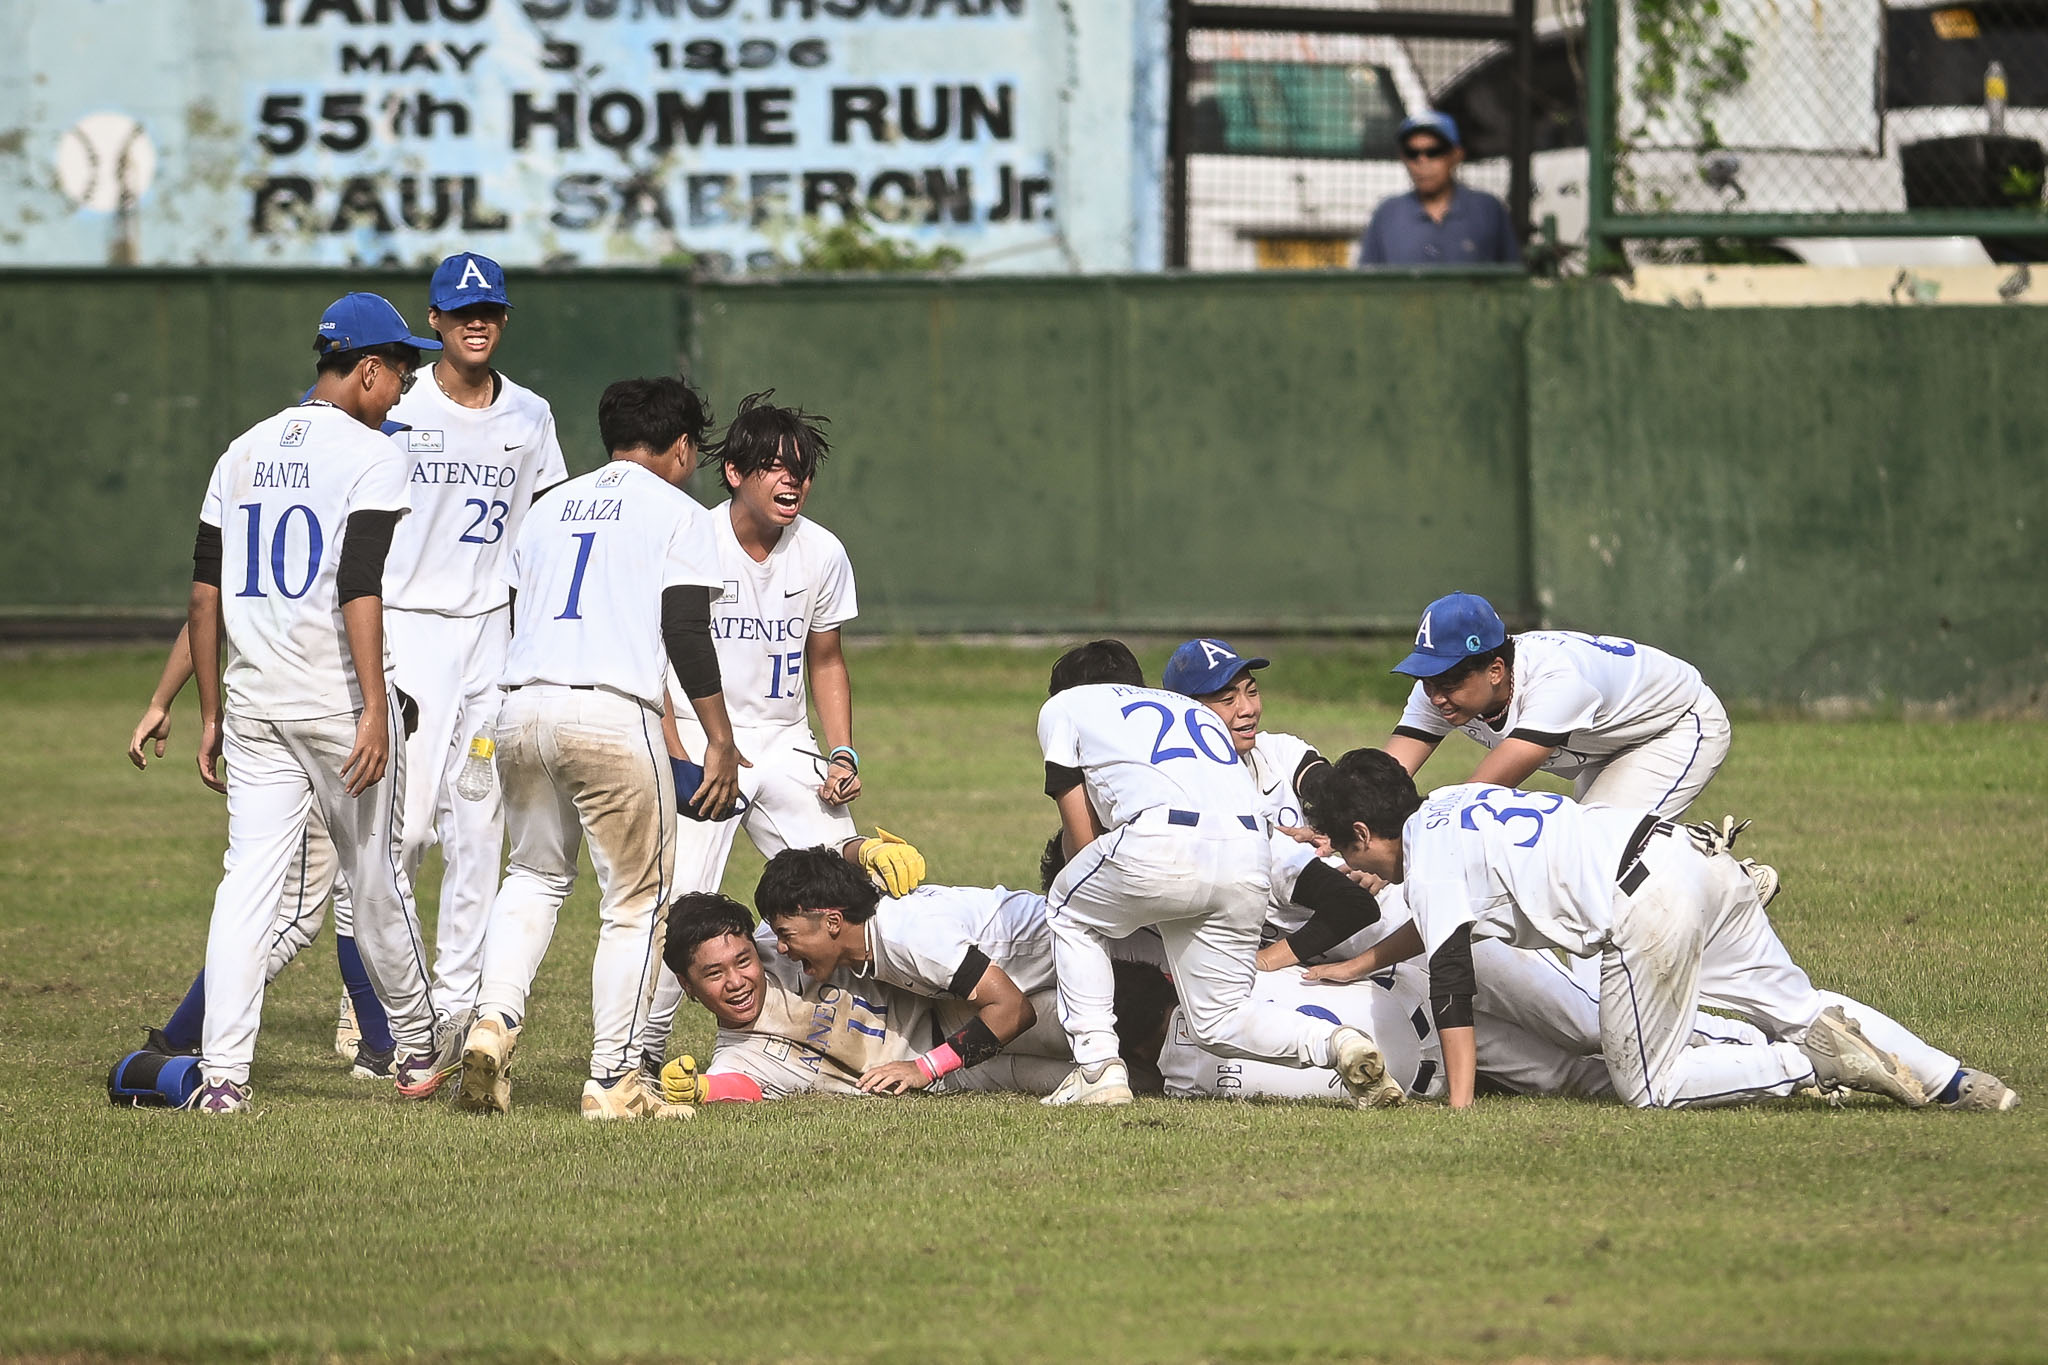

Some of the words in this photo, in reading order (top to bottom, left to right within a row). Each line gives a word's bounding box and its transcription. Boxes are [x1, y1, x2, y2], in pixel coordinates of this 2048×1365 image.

[341, 42, 486, 73] MAY
[512, 88, 795, 150] HOME
[832, 85, 1013, 144] RUN
[456, 258, 492, 290] A
[253, 461, 311, 489] BANTA
[411, 462, 516, 489] ATENEO
[459, 498, 510, 545] 23
[560, 498, 623, 522] BLAZA
[235, 502, 323, 599] 10
[553, 530, 597, 620] 1
[1414, 610, 1435, 650] A
[765, 651, 802, 699] 15
[1199, 640, 1237, 670] A
[1121, 700, 1239, 766] 26
[798, 983, 840, 1074] ANEO
[847, 994, 889, 1045] 11
